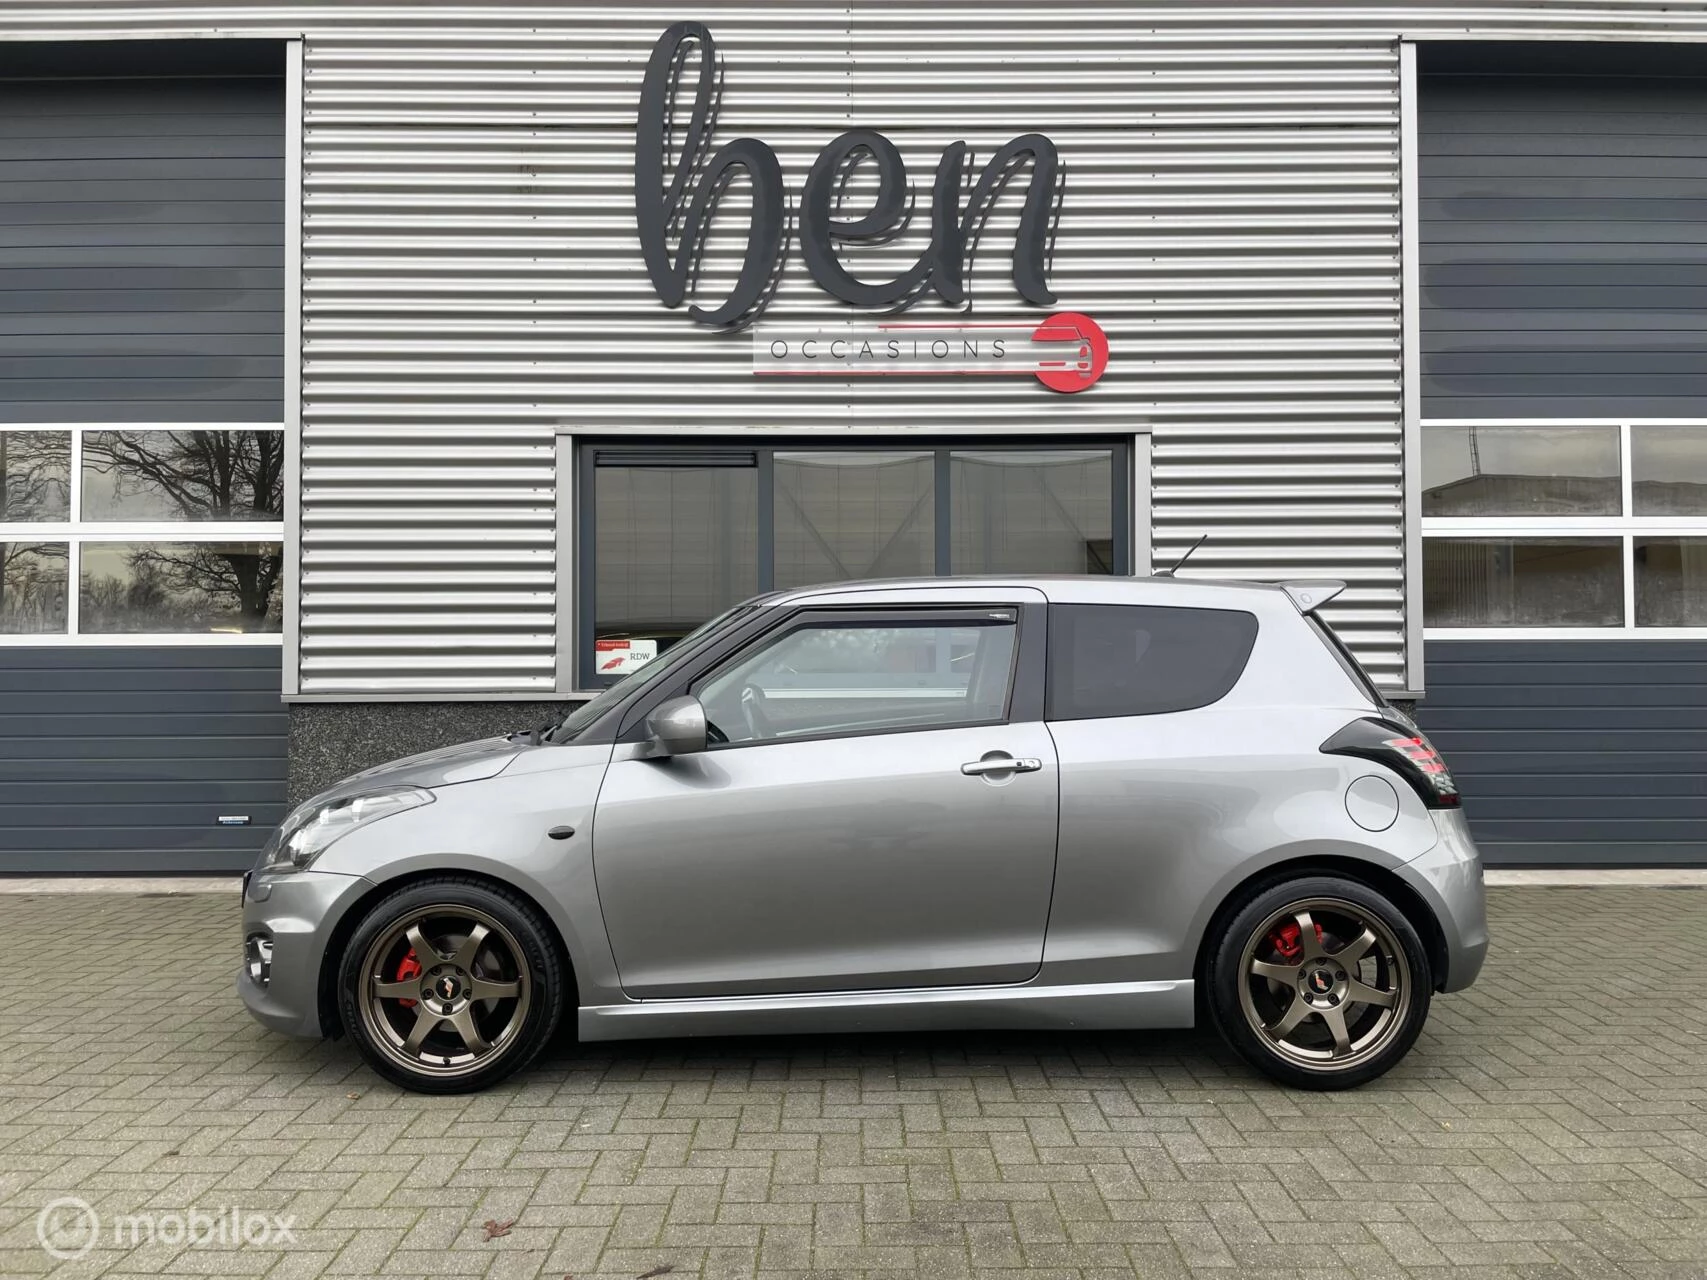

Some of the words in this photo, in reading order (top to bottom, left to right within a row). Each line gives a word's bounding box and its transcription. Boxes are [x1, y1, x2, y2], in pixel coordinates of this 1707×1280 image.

[634, 20, 1058, 325] ben
[770, 339, 1005, 359] OCCASIONS
[629, 652, 650, 661] RDW
